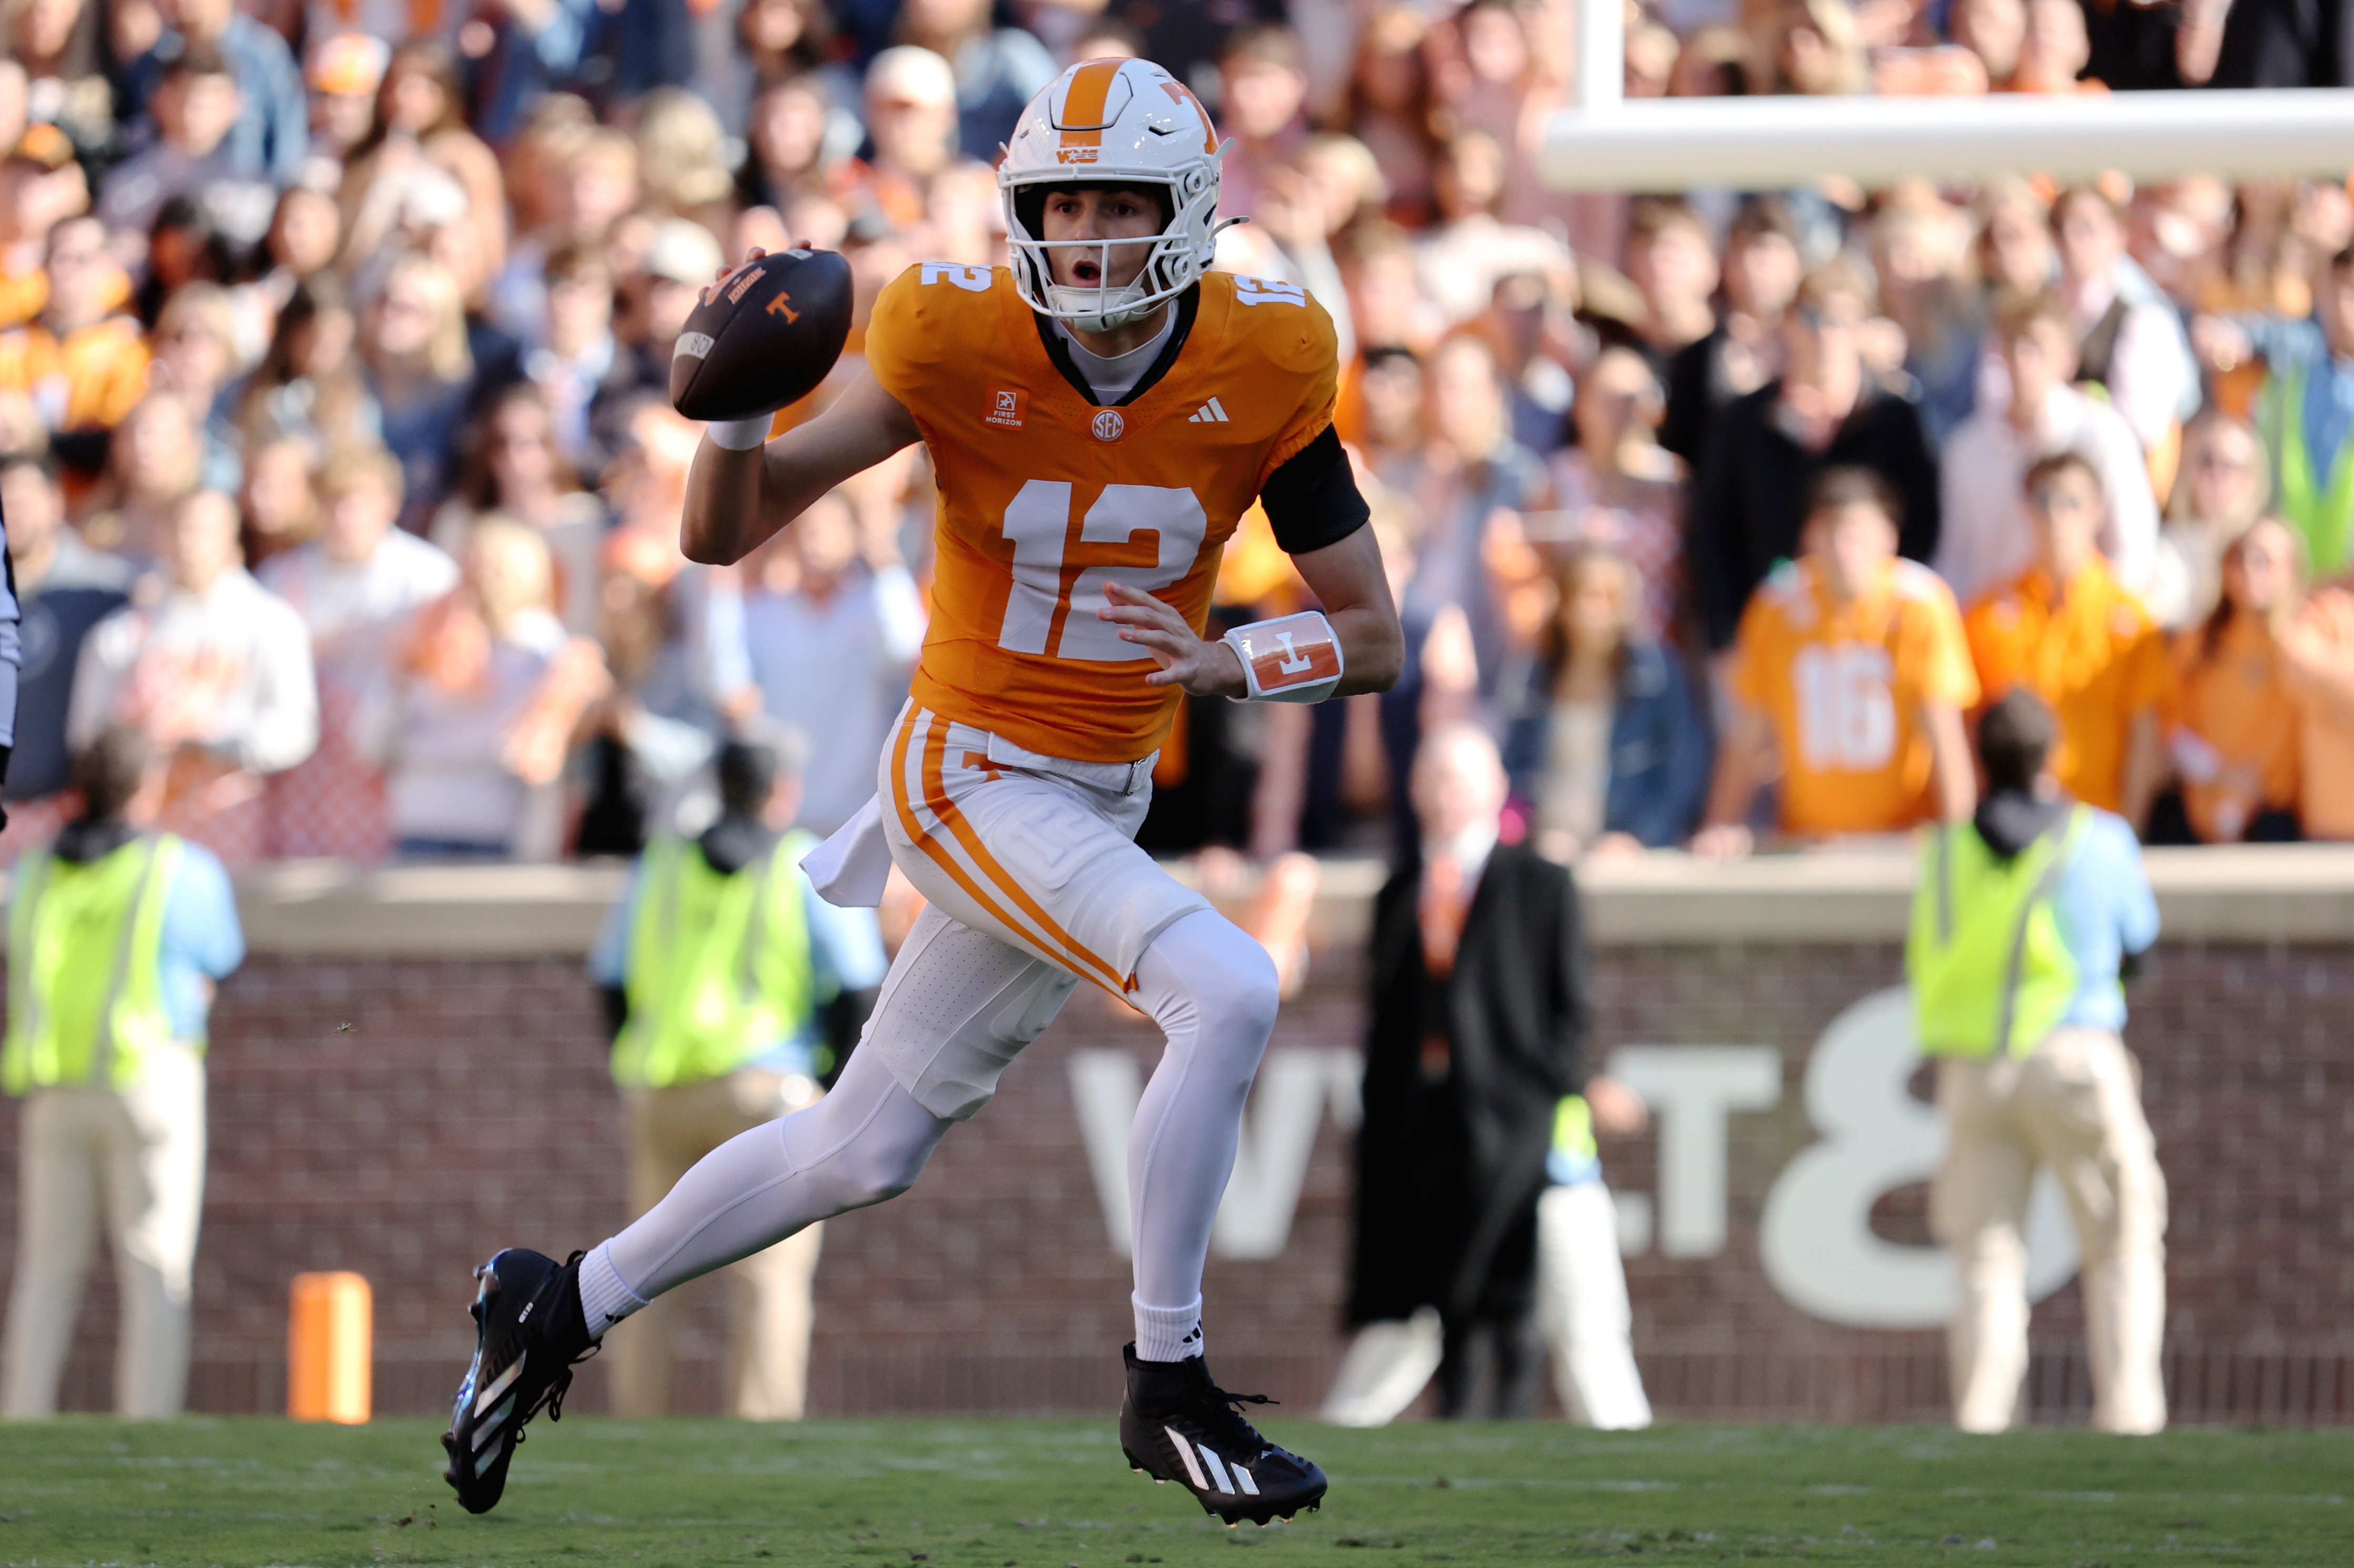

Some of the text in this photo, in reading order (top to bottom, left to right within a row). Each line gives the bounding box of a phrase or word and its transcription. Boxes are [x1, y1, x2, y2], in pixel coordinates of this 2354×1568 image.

[766, 291, 800, 324] T
[986, 417, 1022, 426] HORIZON
[1095, 413, 1121, 439] SEC
[998, 479, 1208, 662] 12
[1274, 630, 1313, 675] T
[1794, 644, 1896, 768] 16
